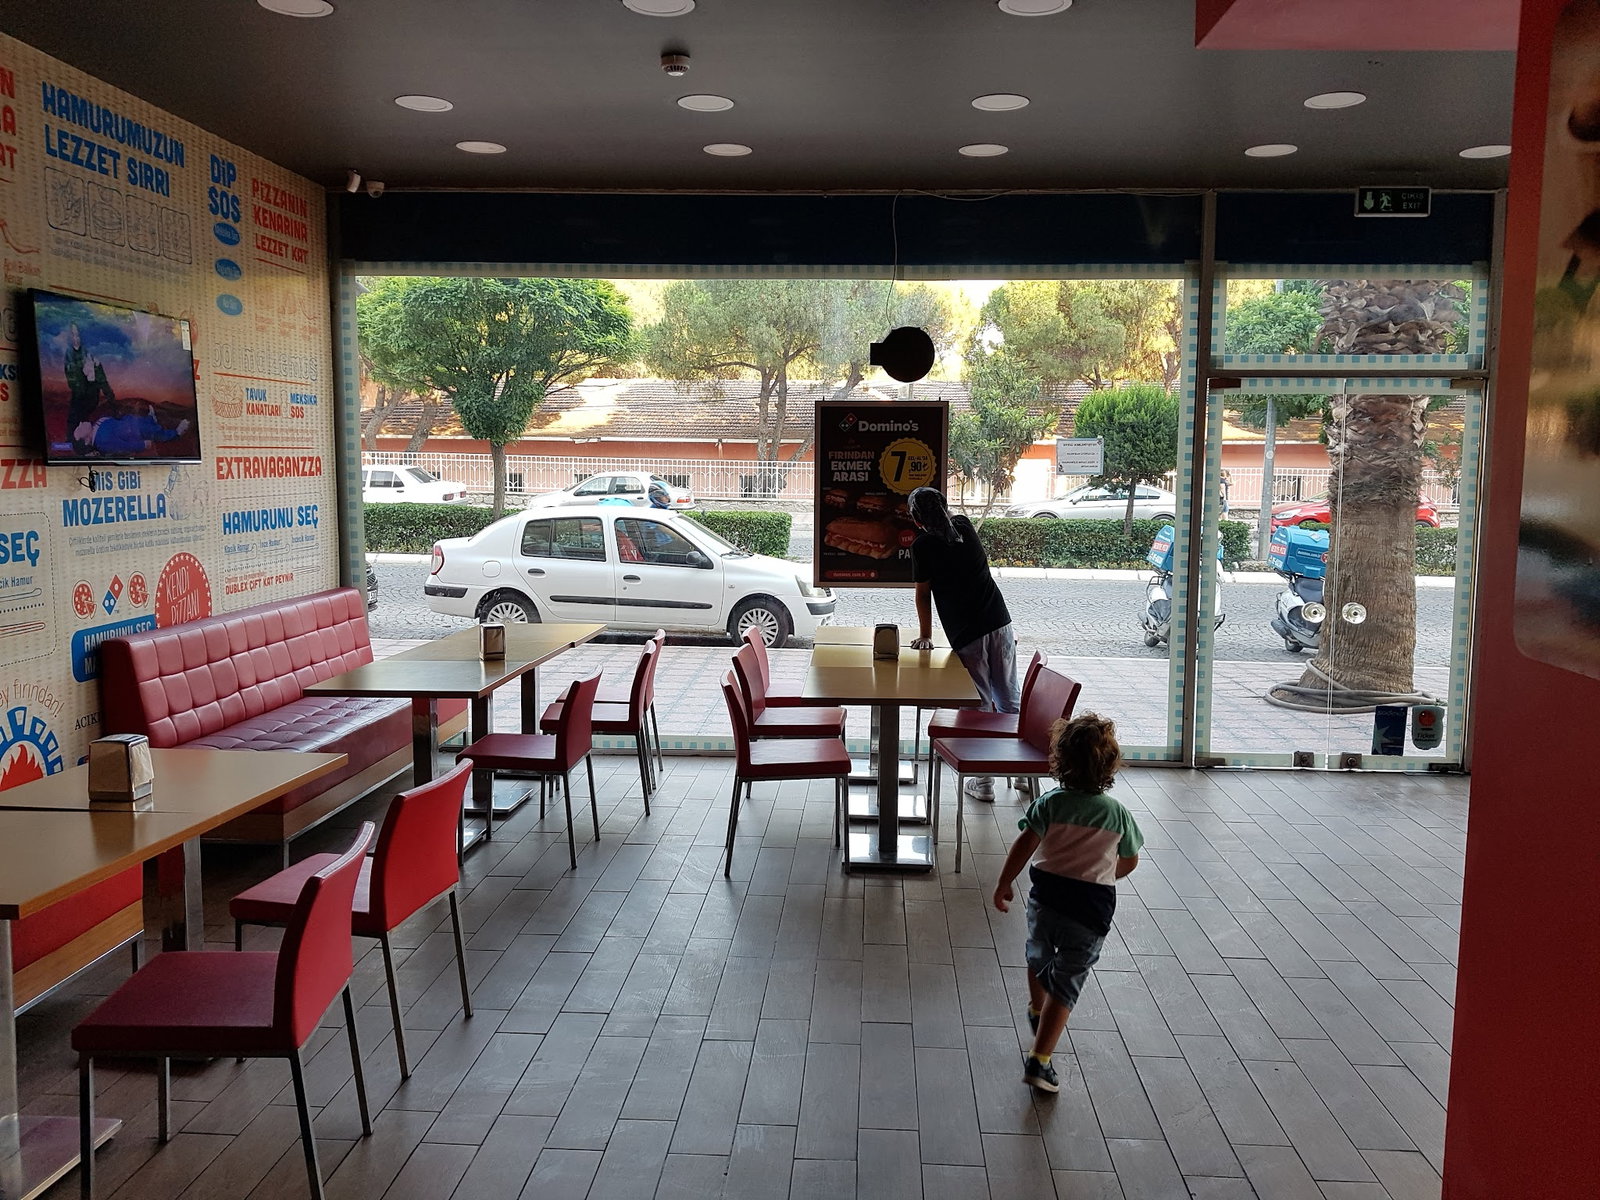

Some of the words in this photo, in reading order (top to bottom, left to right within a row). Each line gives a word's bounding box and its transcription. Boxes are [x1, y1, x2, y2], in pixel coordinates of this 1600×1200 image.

[41, 81, 185, 168] HAMURUMUZUN
[45, 124, 121, 179] LEZZET
[126, 157, 170, 197] SIRRI
[208, 186, 242, 223] SOS
[253, 205, 308, 243] KENARINA
[255, 233, 289, 259] LEZZET
[291, 247, 309, 264] KAT
[245, 388, 267, 402] TAVUK
[246, 403, 281, 417] KANATLARI
[290, 406, 305, 418] SOS
[858, 420, 919, 432] Domino's
[216, 456, 322, 480] EXTRAVAGANZZA
[828, 451, 875, 460] FIRINDAN
[831, 460, 871, 471] EKMEK
[890, 451, 907, 482] 7
[832, 471, 869, 482] ARASI
[62, 493, 167, 527] MOZERELLA
[222, 508, 293, 535] HAMURUNU
[297, 504, 319, 528] SEÇ
[225, 582, 248, 595] DUBLEX
